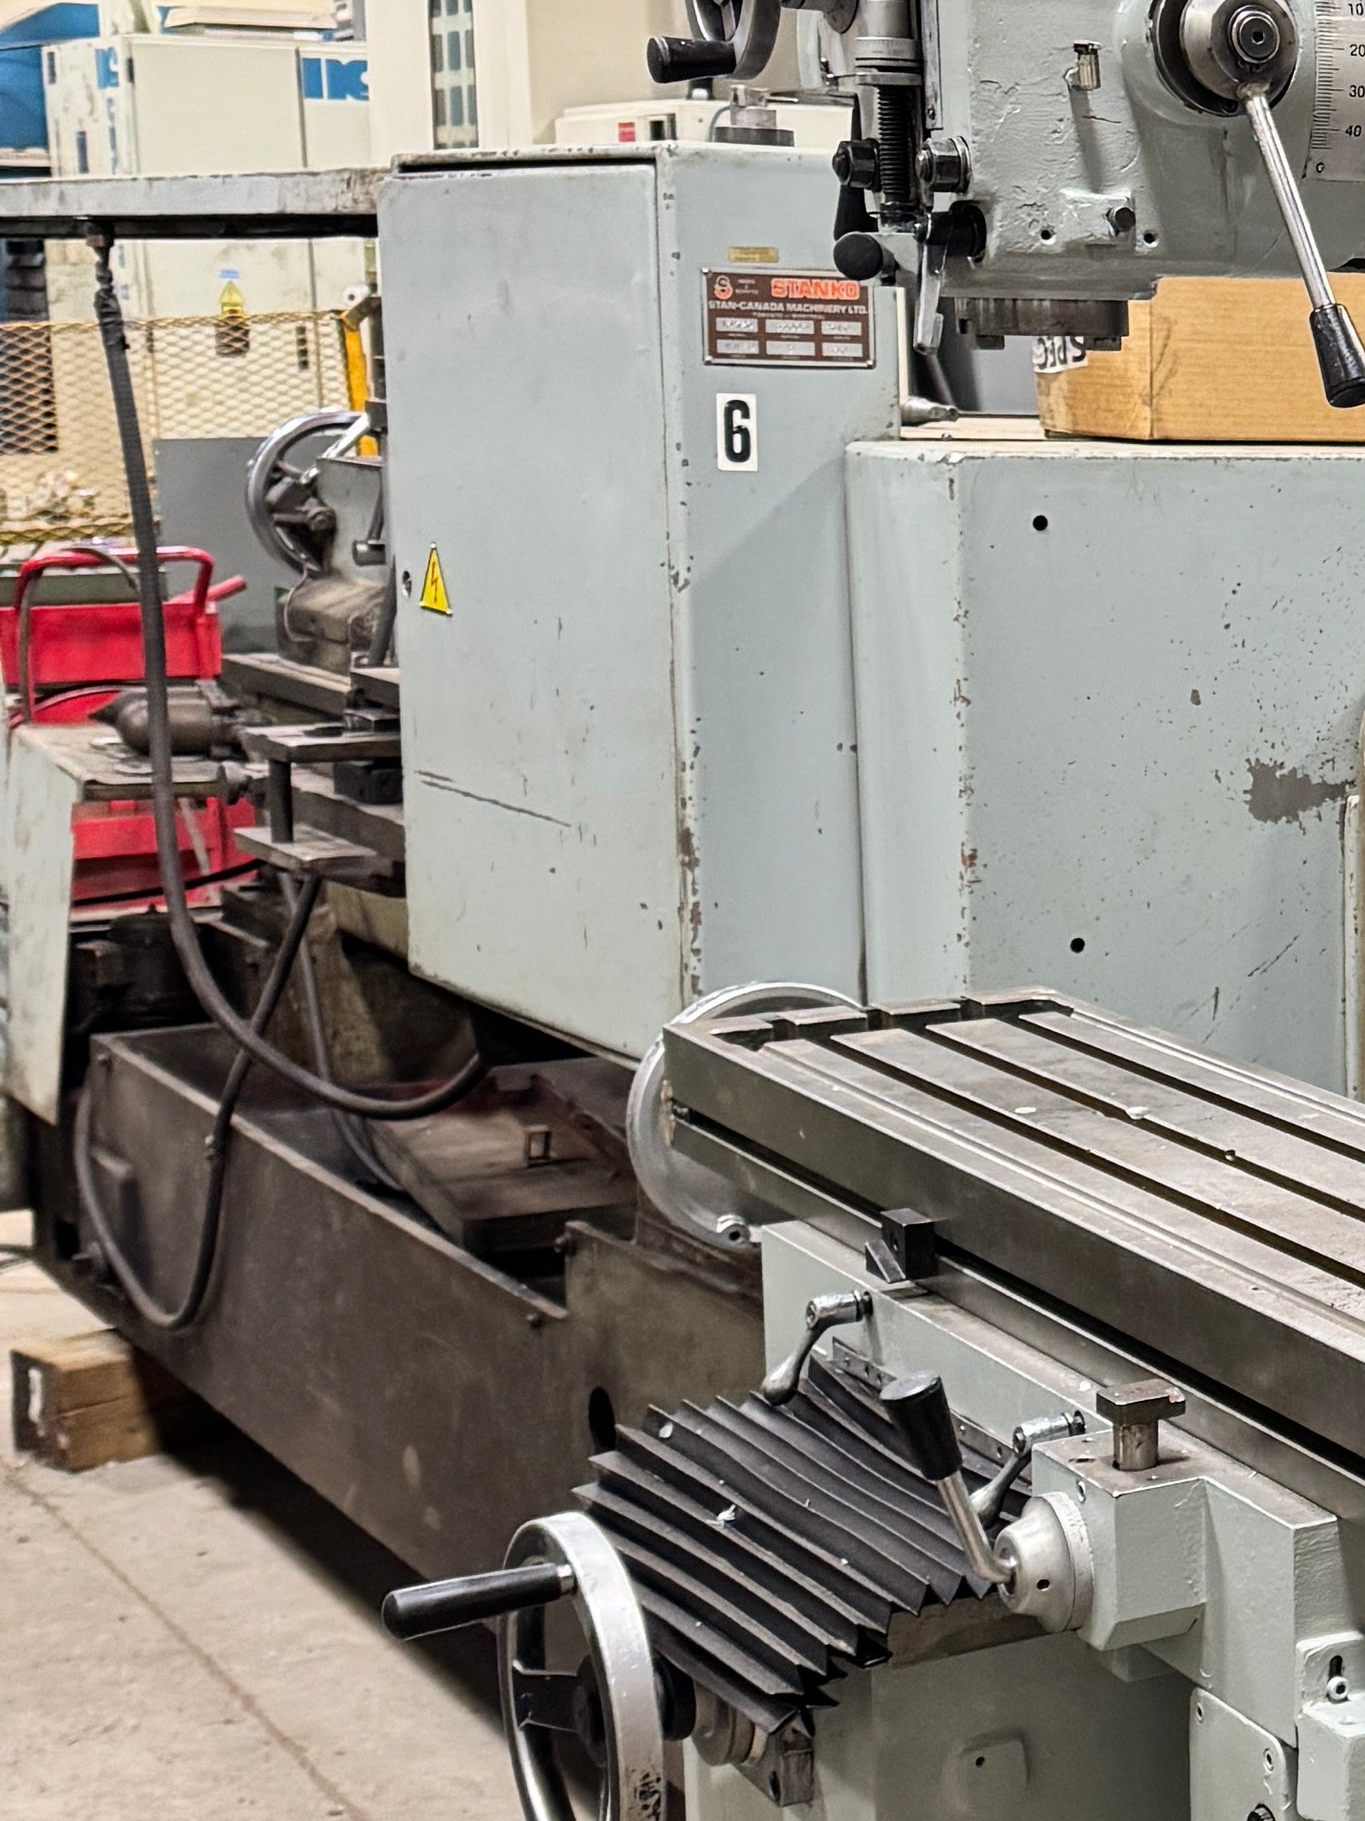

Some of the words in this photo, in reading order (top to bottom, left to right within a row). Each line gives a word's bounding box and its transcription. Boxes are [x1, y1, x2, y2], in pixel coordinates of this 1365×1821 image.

[1348, 2, 1364, 16] 10
[1350, 44, 1365, 57] 20
[1349, 85, 1365, 99] 30
[1345, 124, 1362, 137] 40
[771, 278, 860, 300] STANKO
[708, 300, 784, 312] STAN-CANADA
[786, 303, 847, 314] MACHINERY
[723, 399, 751, 463] 6
